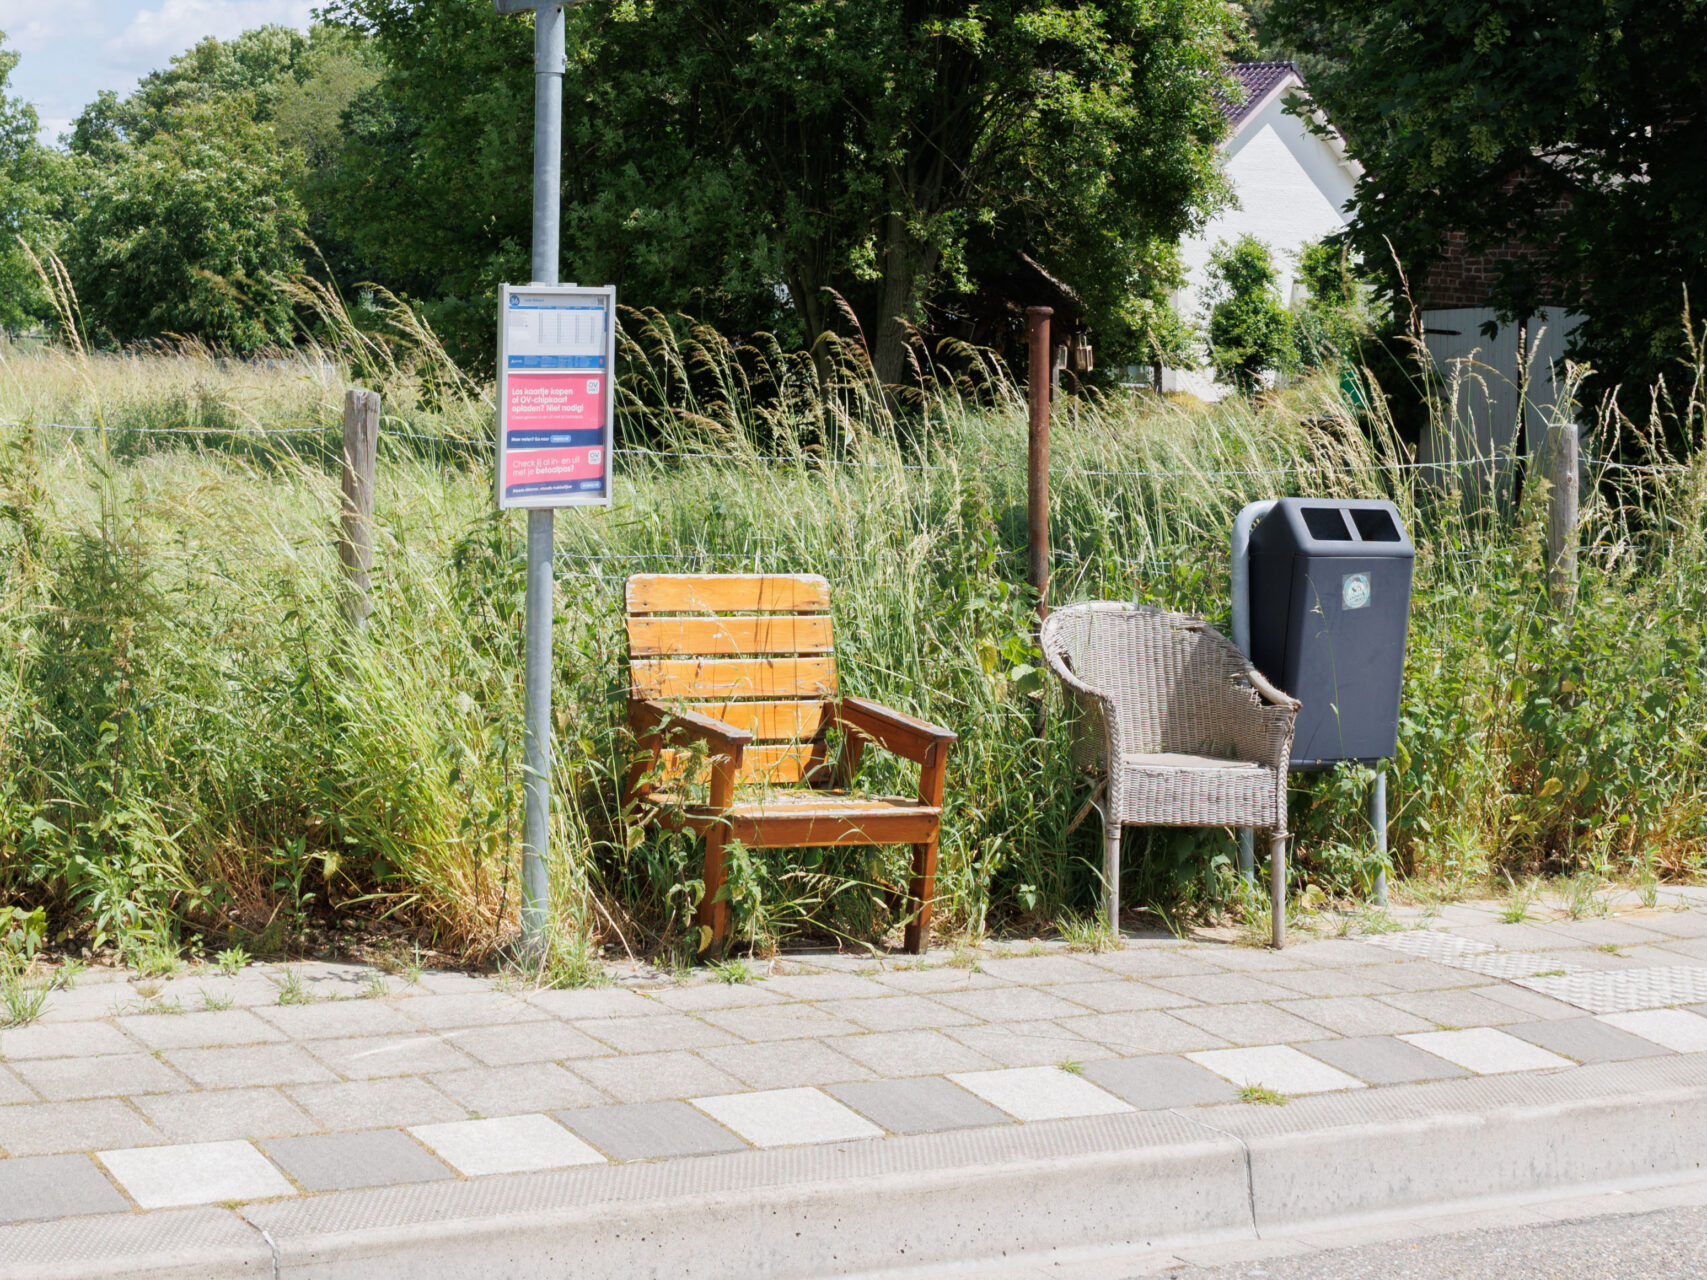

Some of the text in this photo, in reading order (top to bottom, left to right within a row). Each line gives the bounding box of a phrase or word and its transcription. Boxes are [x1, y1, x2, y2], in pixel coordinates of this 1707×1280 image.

[524, 387, 548, 397] kaartje
[550, 387, 573, 396] kopen
[512, 396, 568, 405] of OV-chipkaart
[512, 404, 544, 413] opladen?
[562, 404, 584, 413] nodig!
[512, 459, 535, 468] Check
[572, 456, 580, 464] uit
[512, 465, 575, 477] met je betaalpas?
